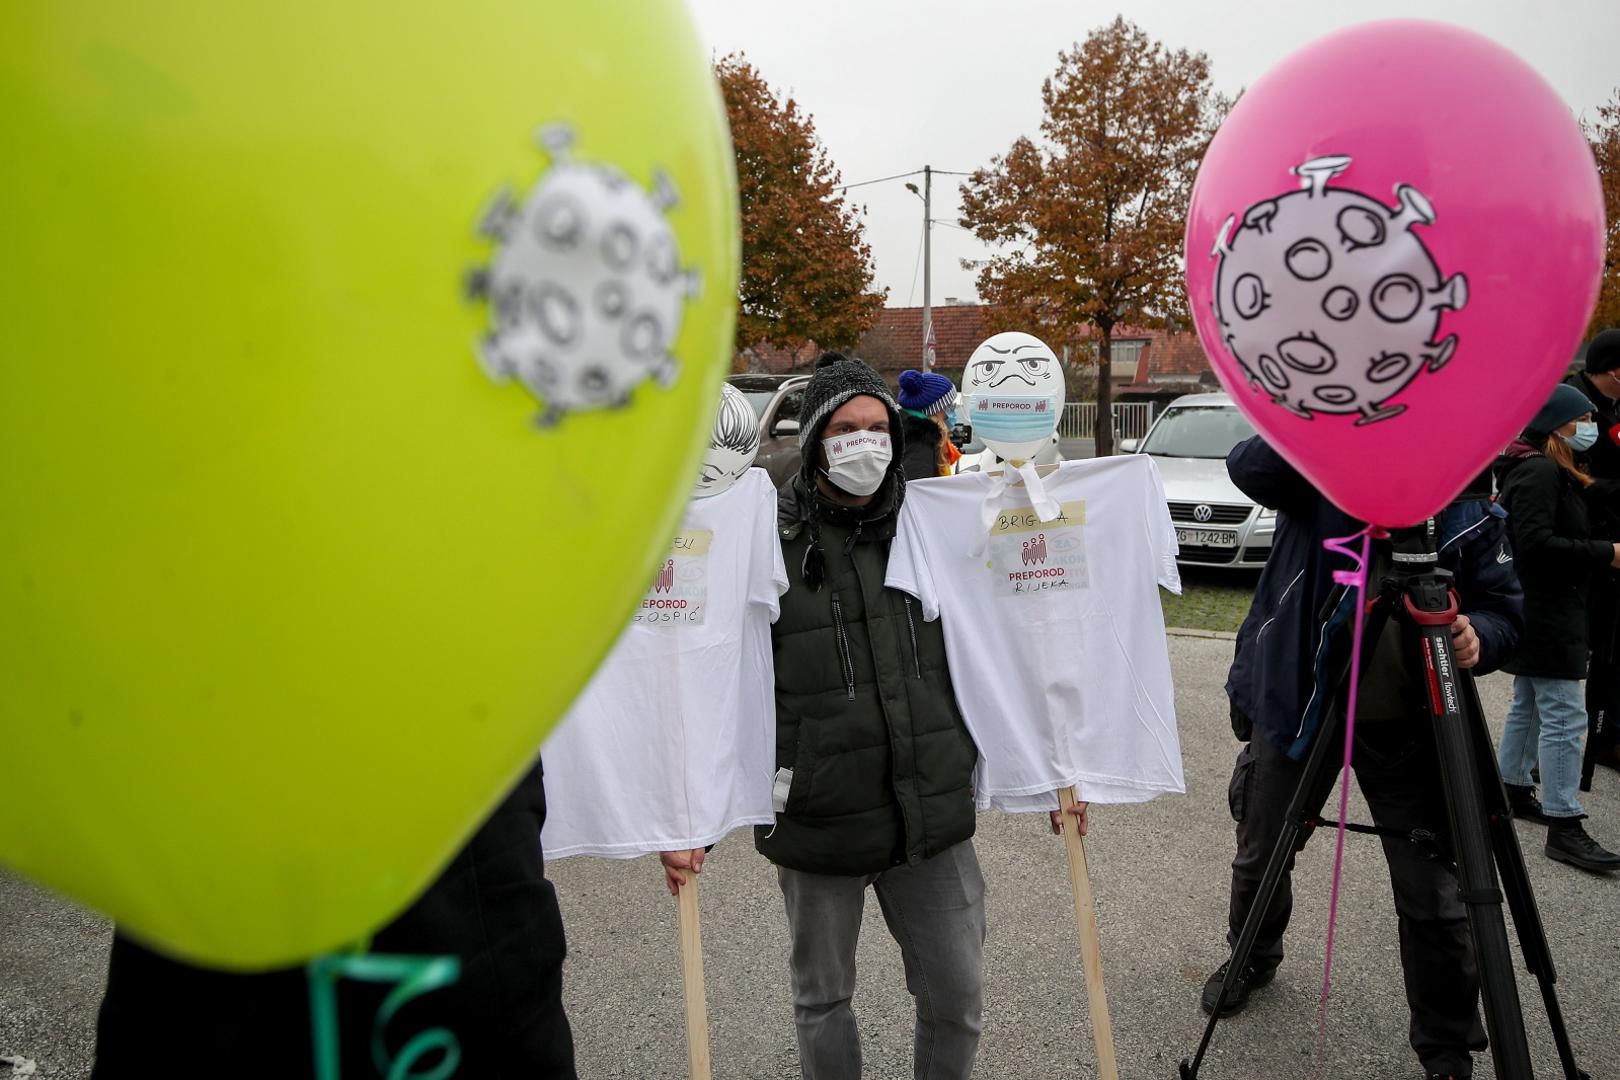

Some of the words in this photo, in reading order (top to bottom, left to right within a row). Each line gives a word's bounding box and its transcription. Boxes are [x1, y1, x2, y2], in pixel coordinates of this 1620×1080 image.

[992, 402, 1031, 410] PREPOROD
[1009, 567, 1065, 581] PREPOROD
[1015, 580, 1068, 593] RIJEKA
[641, 599, 687, 609] EPOROD
[1435, 636, 1449, 678] sachtler
[1444, 681, 1457, 713] flowtech
